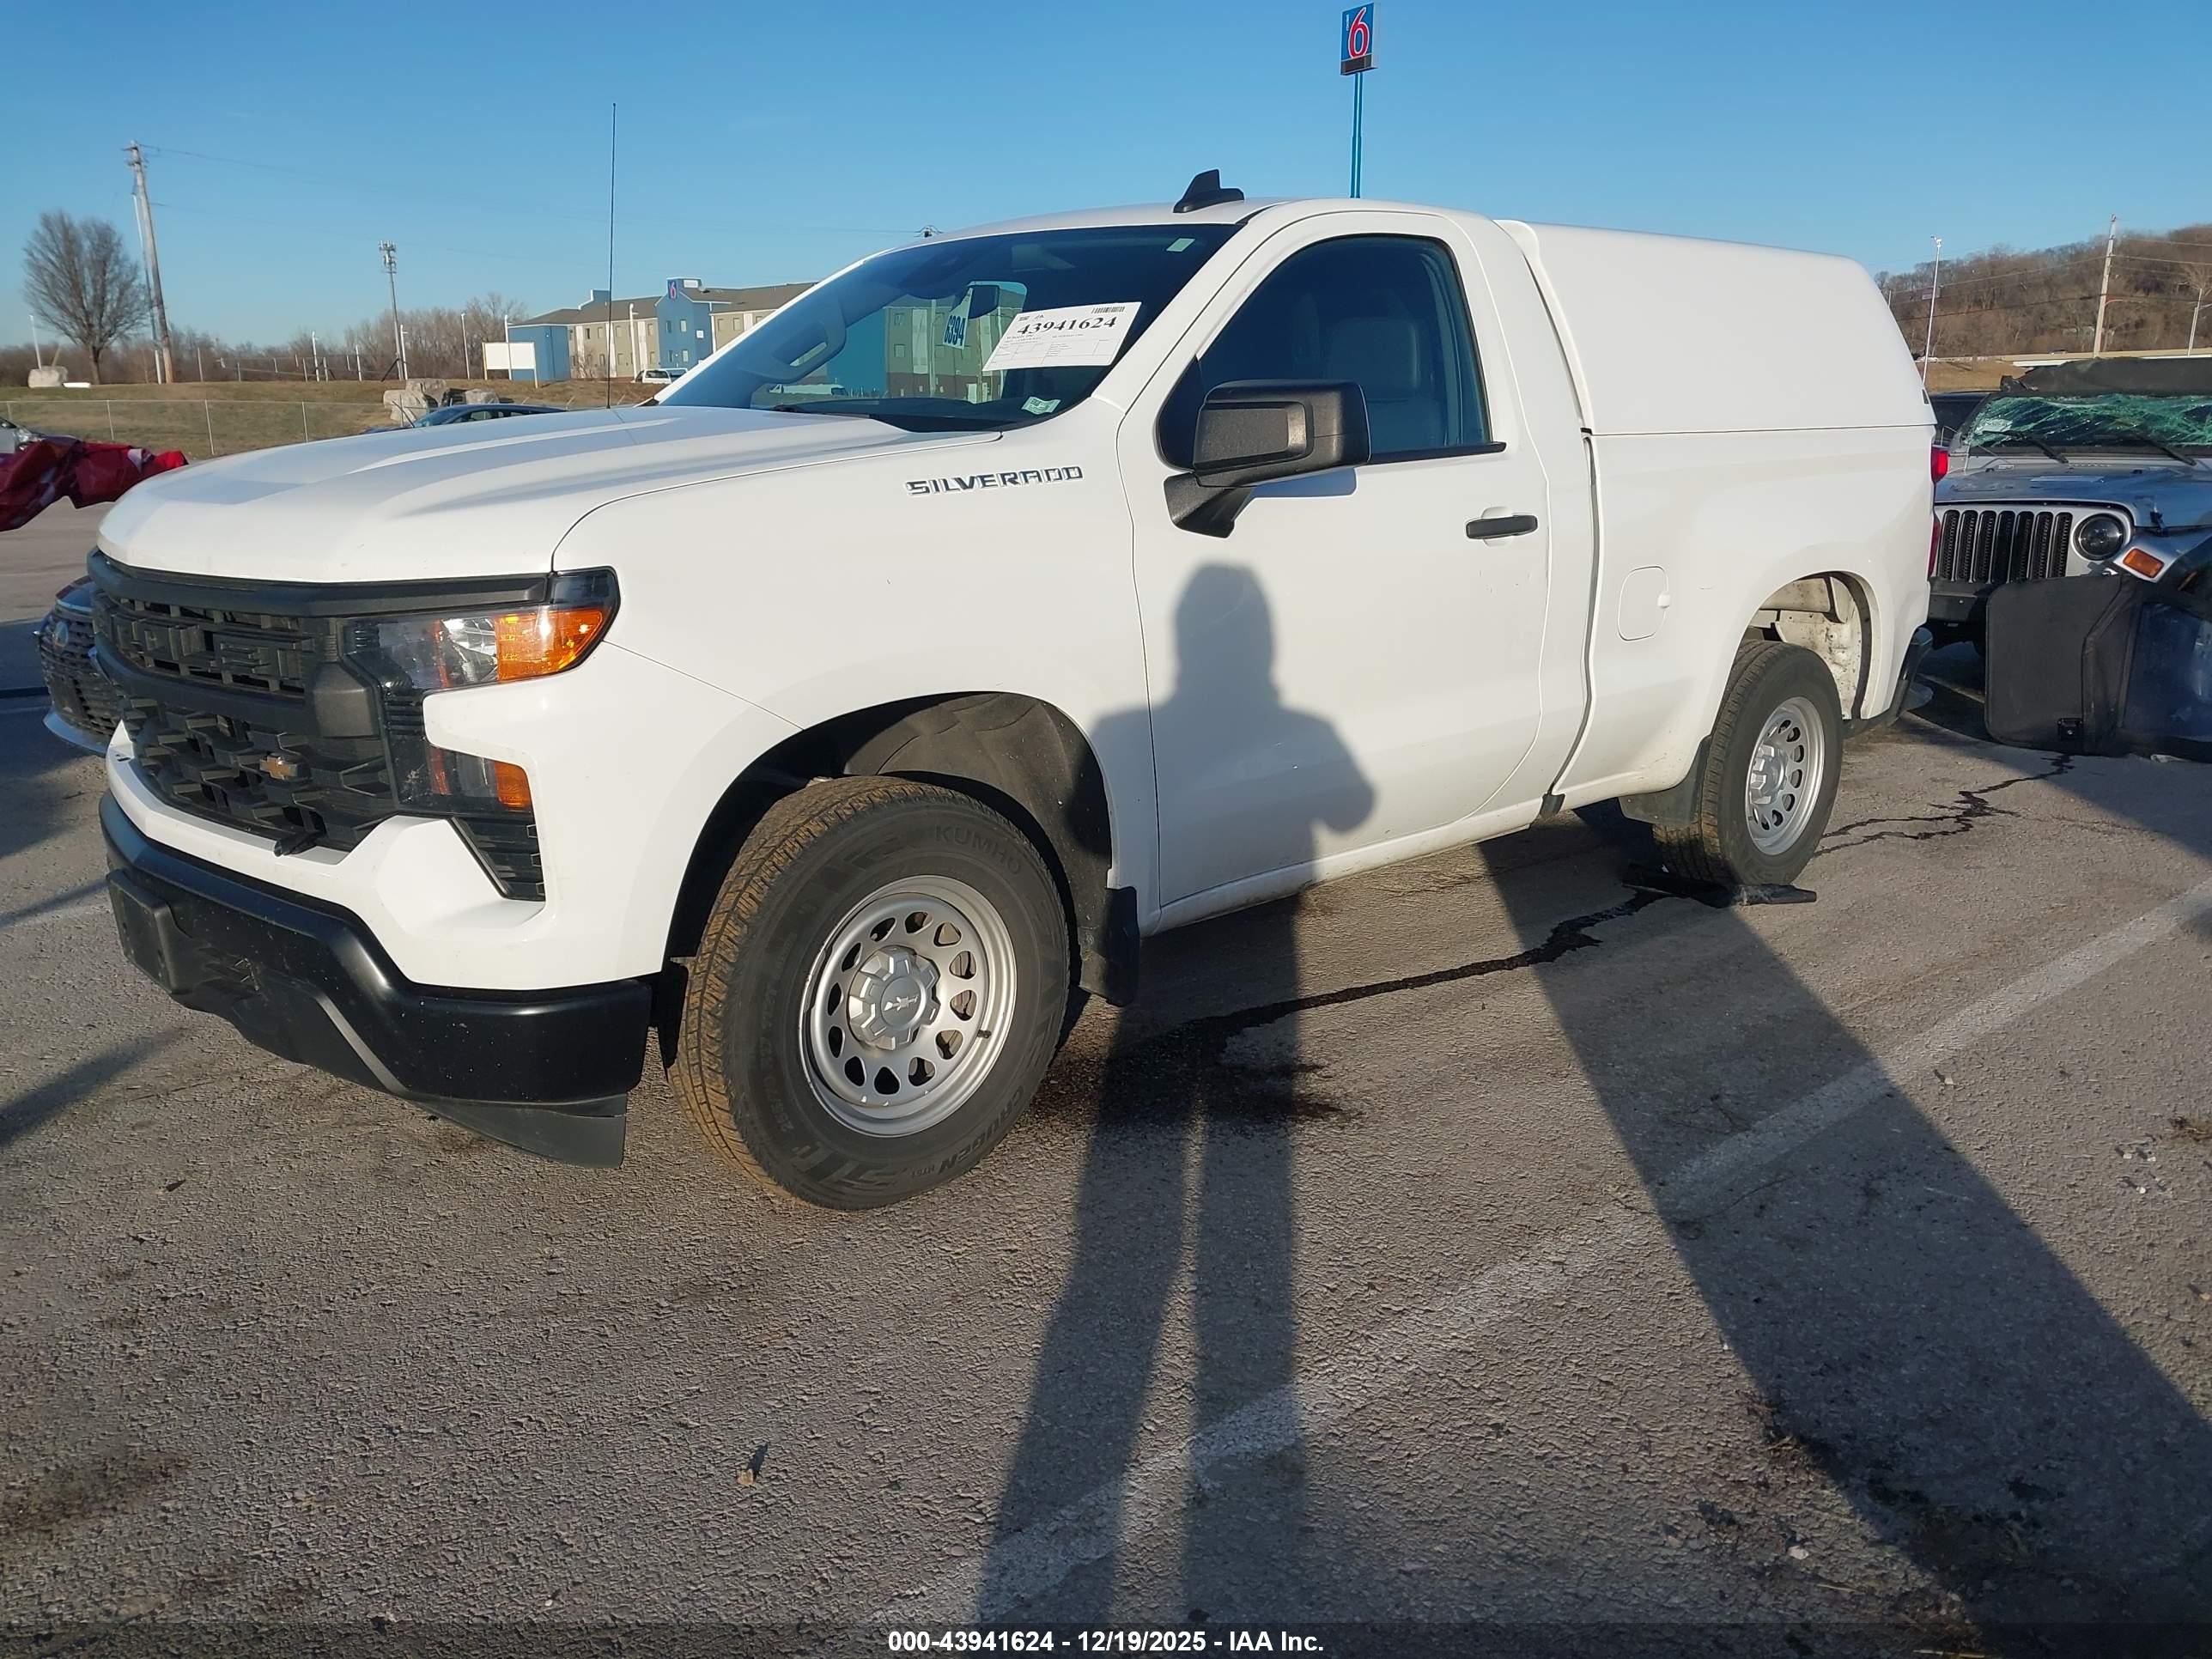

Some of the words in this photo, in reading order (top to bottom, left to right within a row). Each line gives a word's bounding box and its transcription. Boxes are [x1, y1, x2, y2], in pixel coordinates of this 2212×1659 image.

[1349, 7, 1370, 58] 6
[1018, 316, 1117, 335] 43941624
[906, 465, 1084, 495] SILVERADO
[934, 823, 1022, 875] KUMHO
